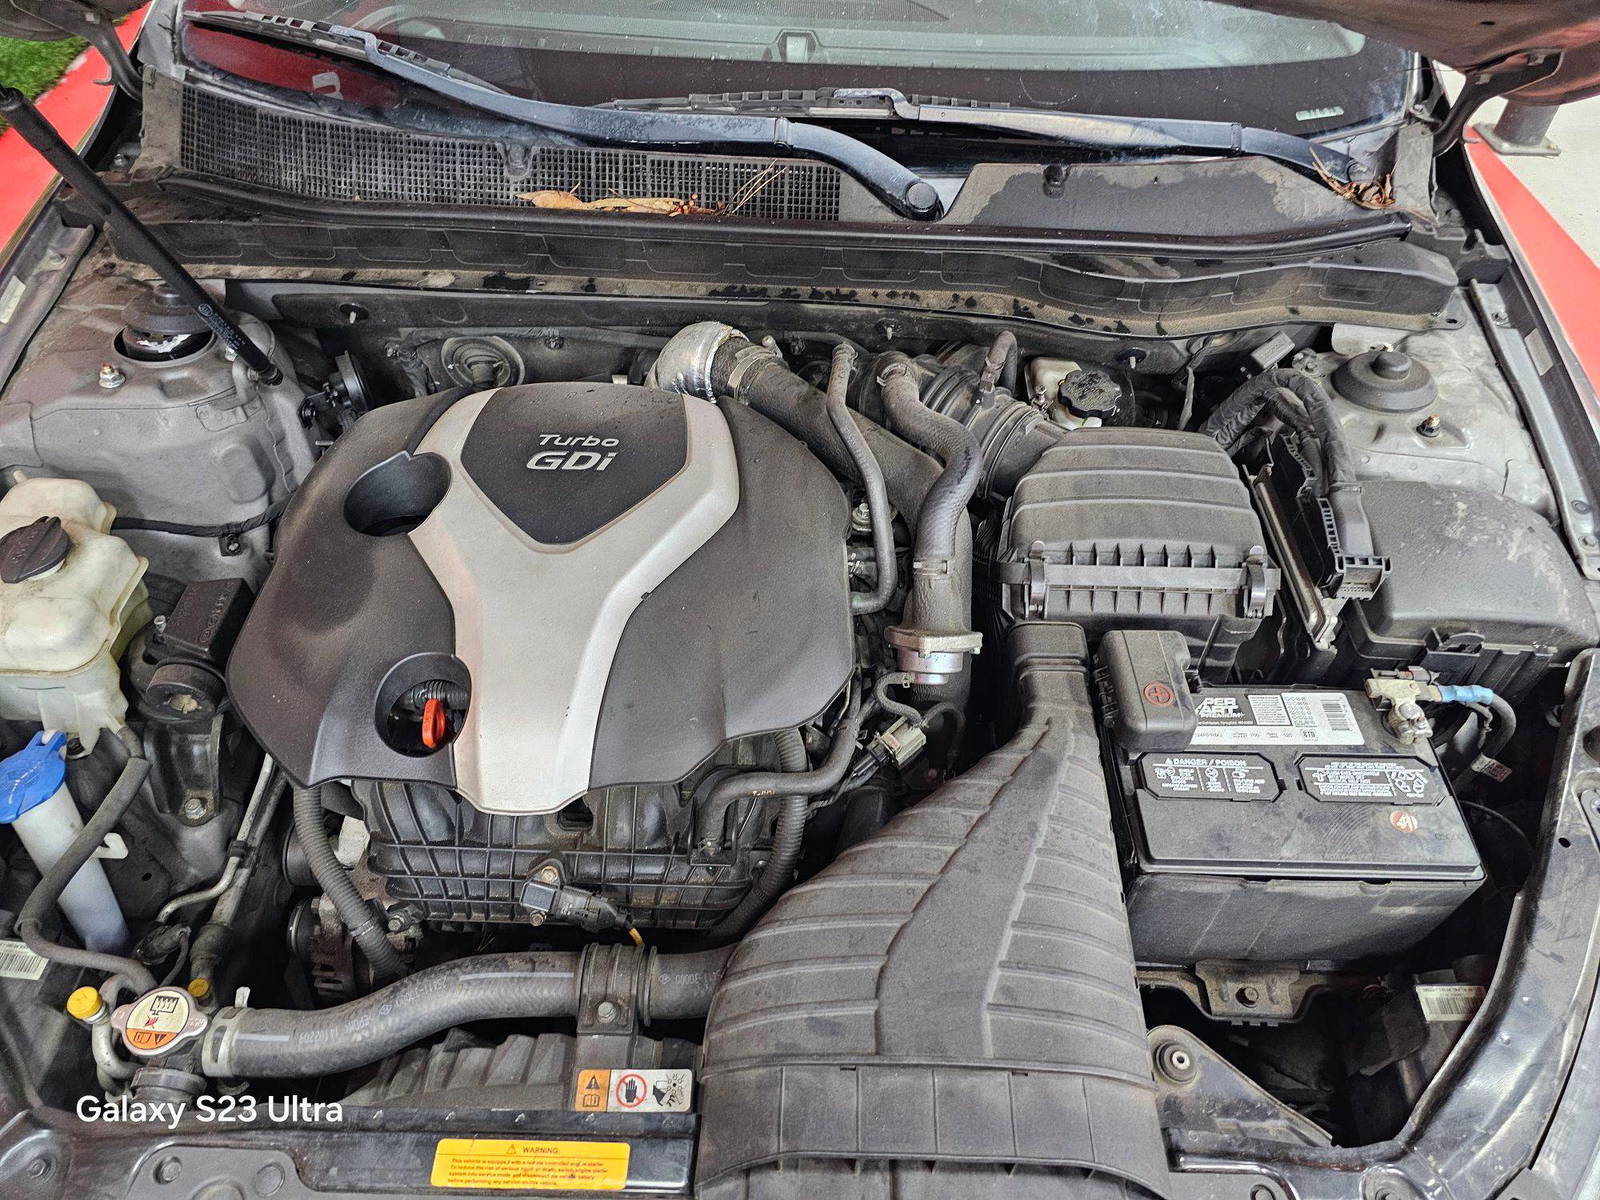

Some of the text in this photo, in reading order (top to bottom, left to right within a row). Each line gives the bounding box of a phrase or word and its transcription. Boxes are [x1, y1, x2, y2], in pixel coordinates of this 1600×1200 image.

[539, 434, 620, 447] Turbo
[526, 451, 619, 471] GDi
[1214, 759, 1247, 767] POISON
